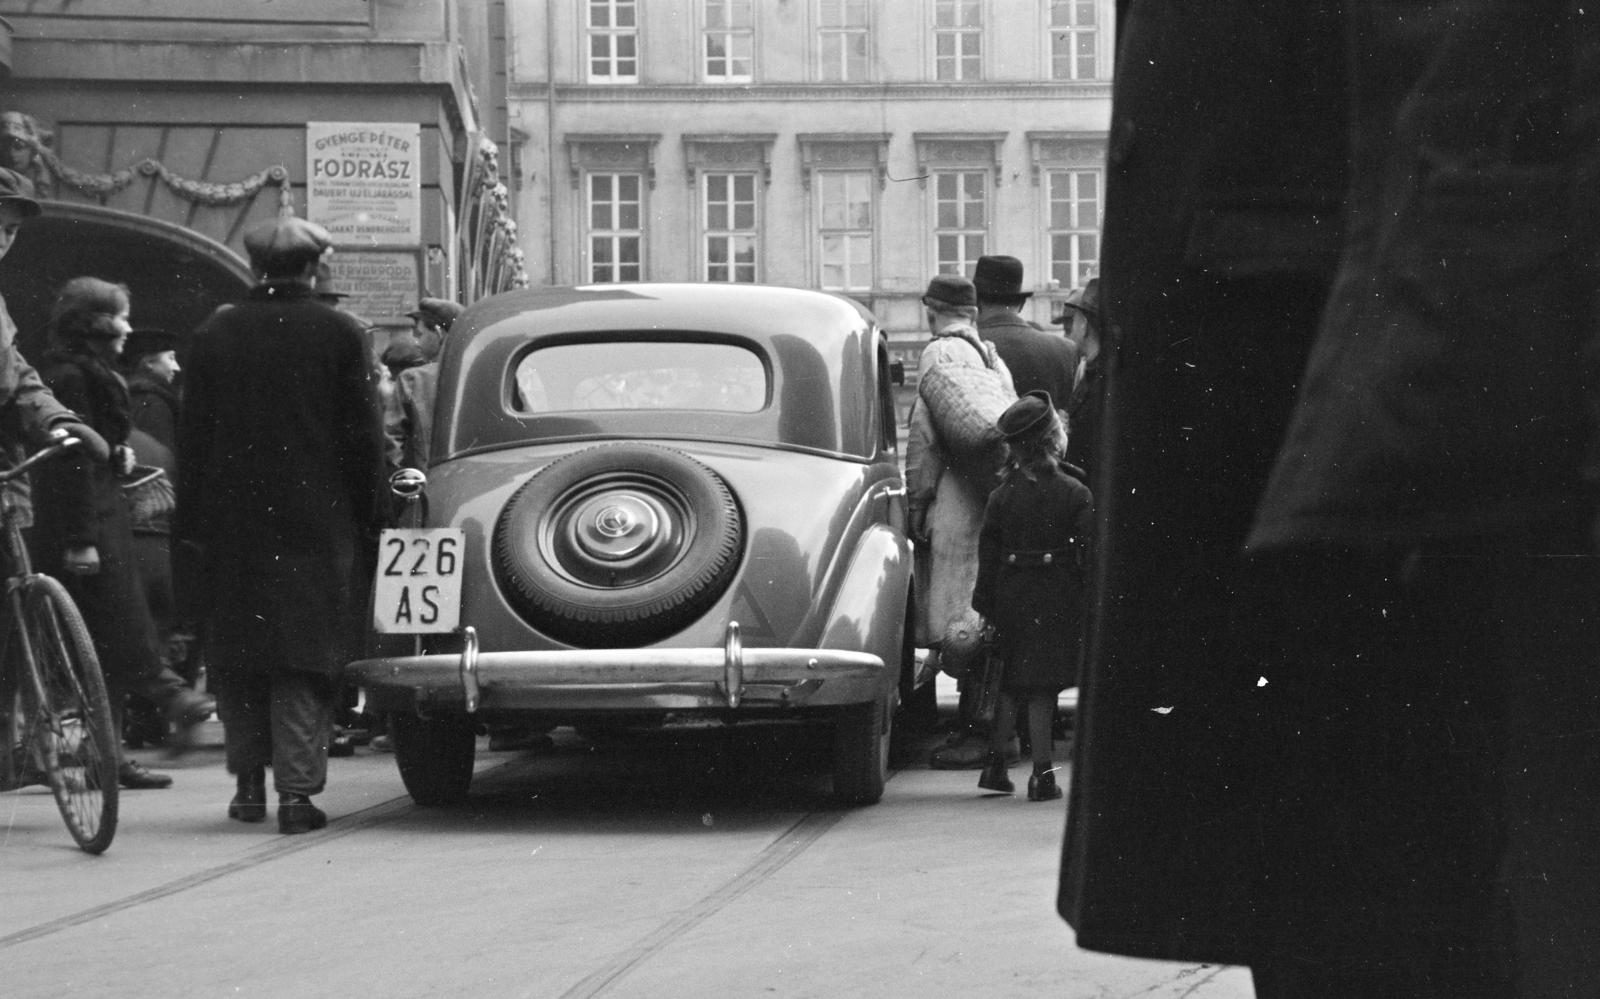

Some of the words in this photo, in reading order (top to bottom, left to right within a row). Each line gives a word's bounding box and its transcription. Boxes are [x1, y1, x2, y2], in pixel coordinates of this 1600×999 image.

[315, 132, 367, 150] GYENGE
[370, 130, 410, 152] PÉTER
[313, 158, 411, 179] FODRÁSZ
[384, 538, 456, 576] 226
[395, 585, 439, 624] AS
